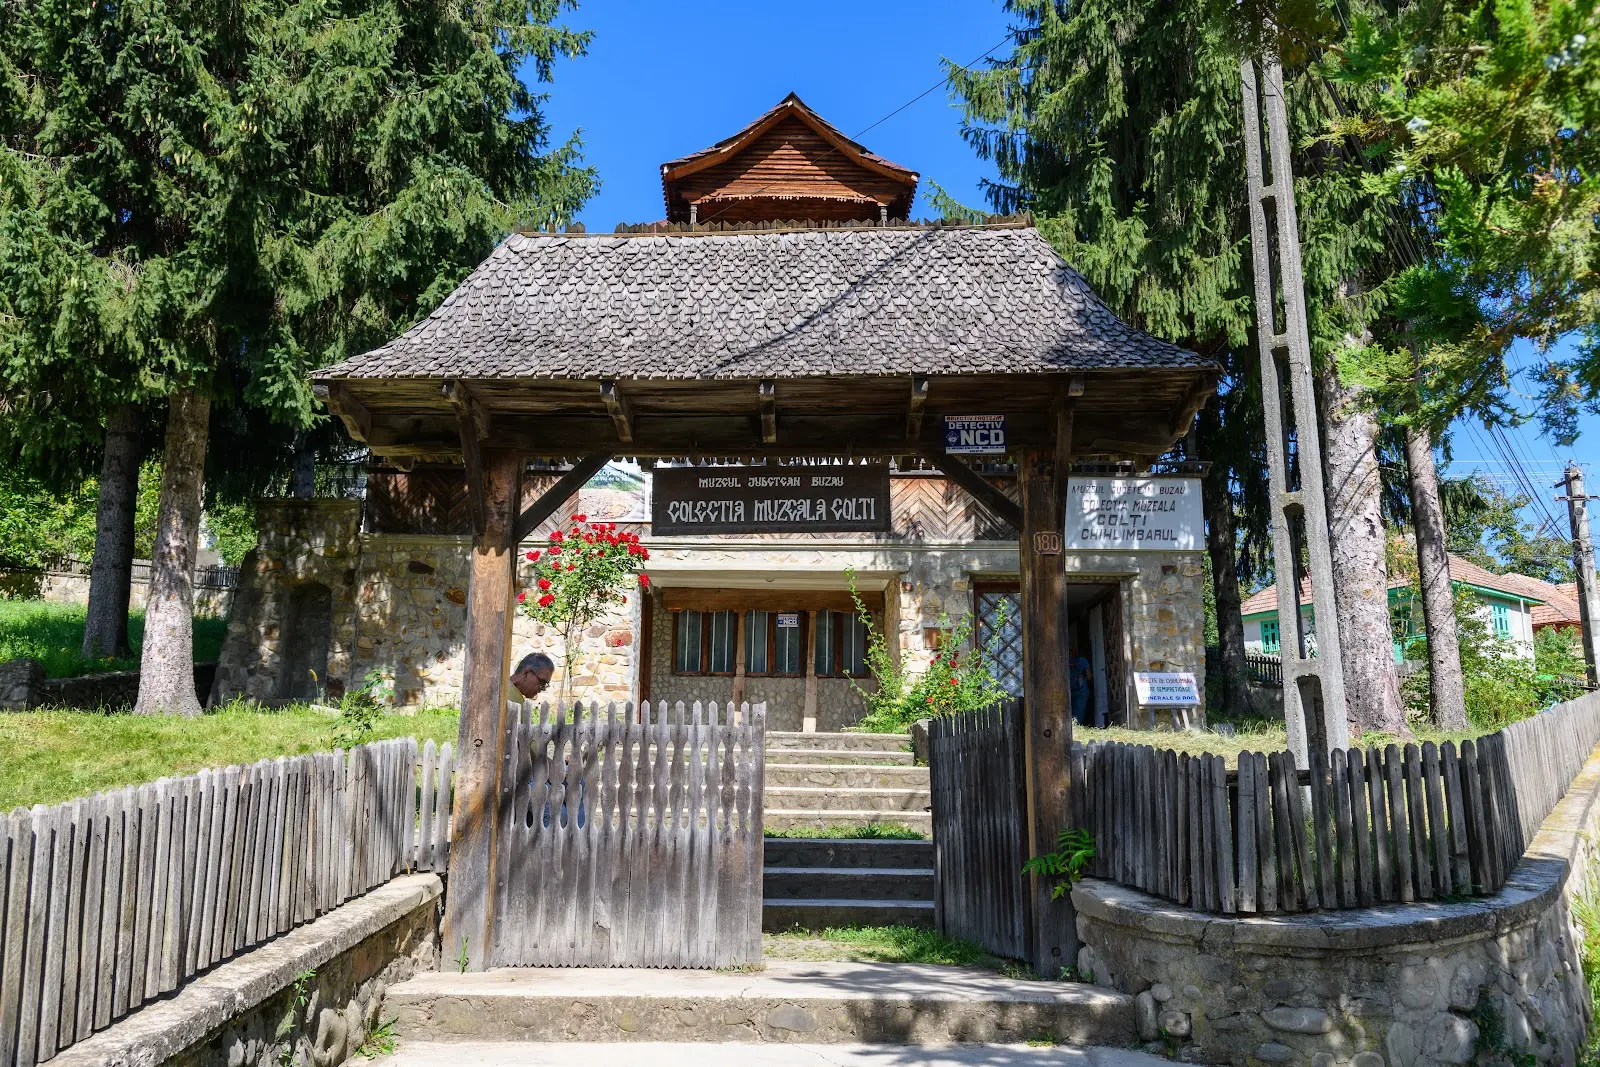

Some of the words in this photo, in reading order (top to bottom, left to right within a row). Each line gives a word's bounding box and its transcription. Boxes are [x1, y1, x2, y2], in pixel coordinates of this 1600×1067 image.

[948, 421, 1003, 429] DETECTIV
[960, 429, 1005, 445] NCD
[699, 477, 741, 488] MUZEUL
[811, 476, 844, 487] BUZAU
[667, 500, 745, 523] COLECTIA
[754, 498, 827, 522] MUZEALA
[830, 497, 875, 521] COLTI
[1080, 528, 1177, 540] CHIHLIMBARUL
[1036, 534, 1059, 551] 180
